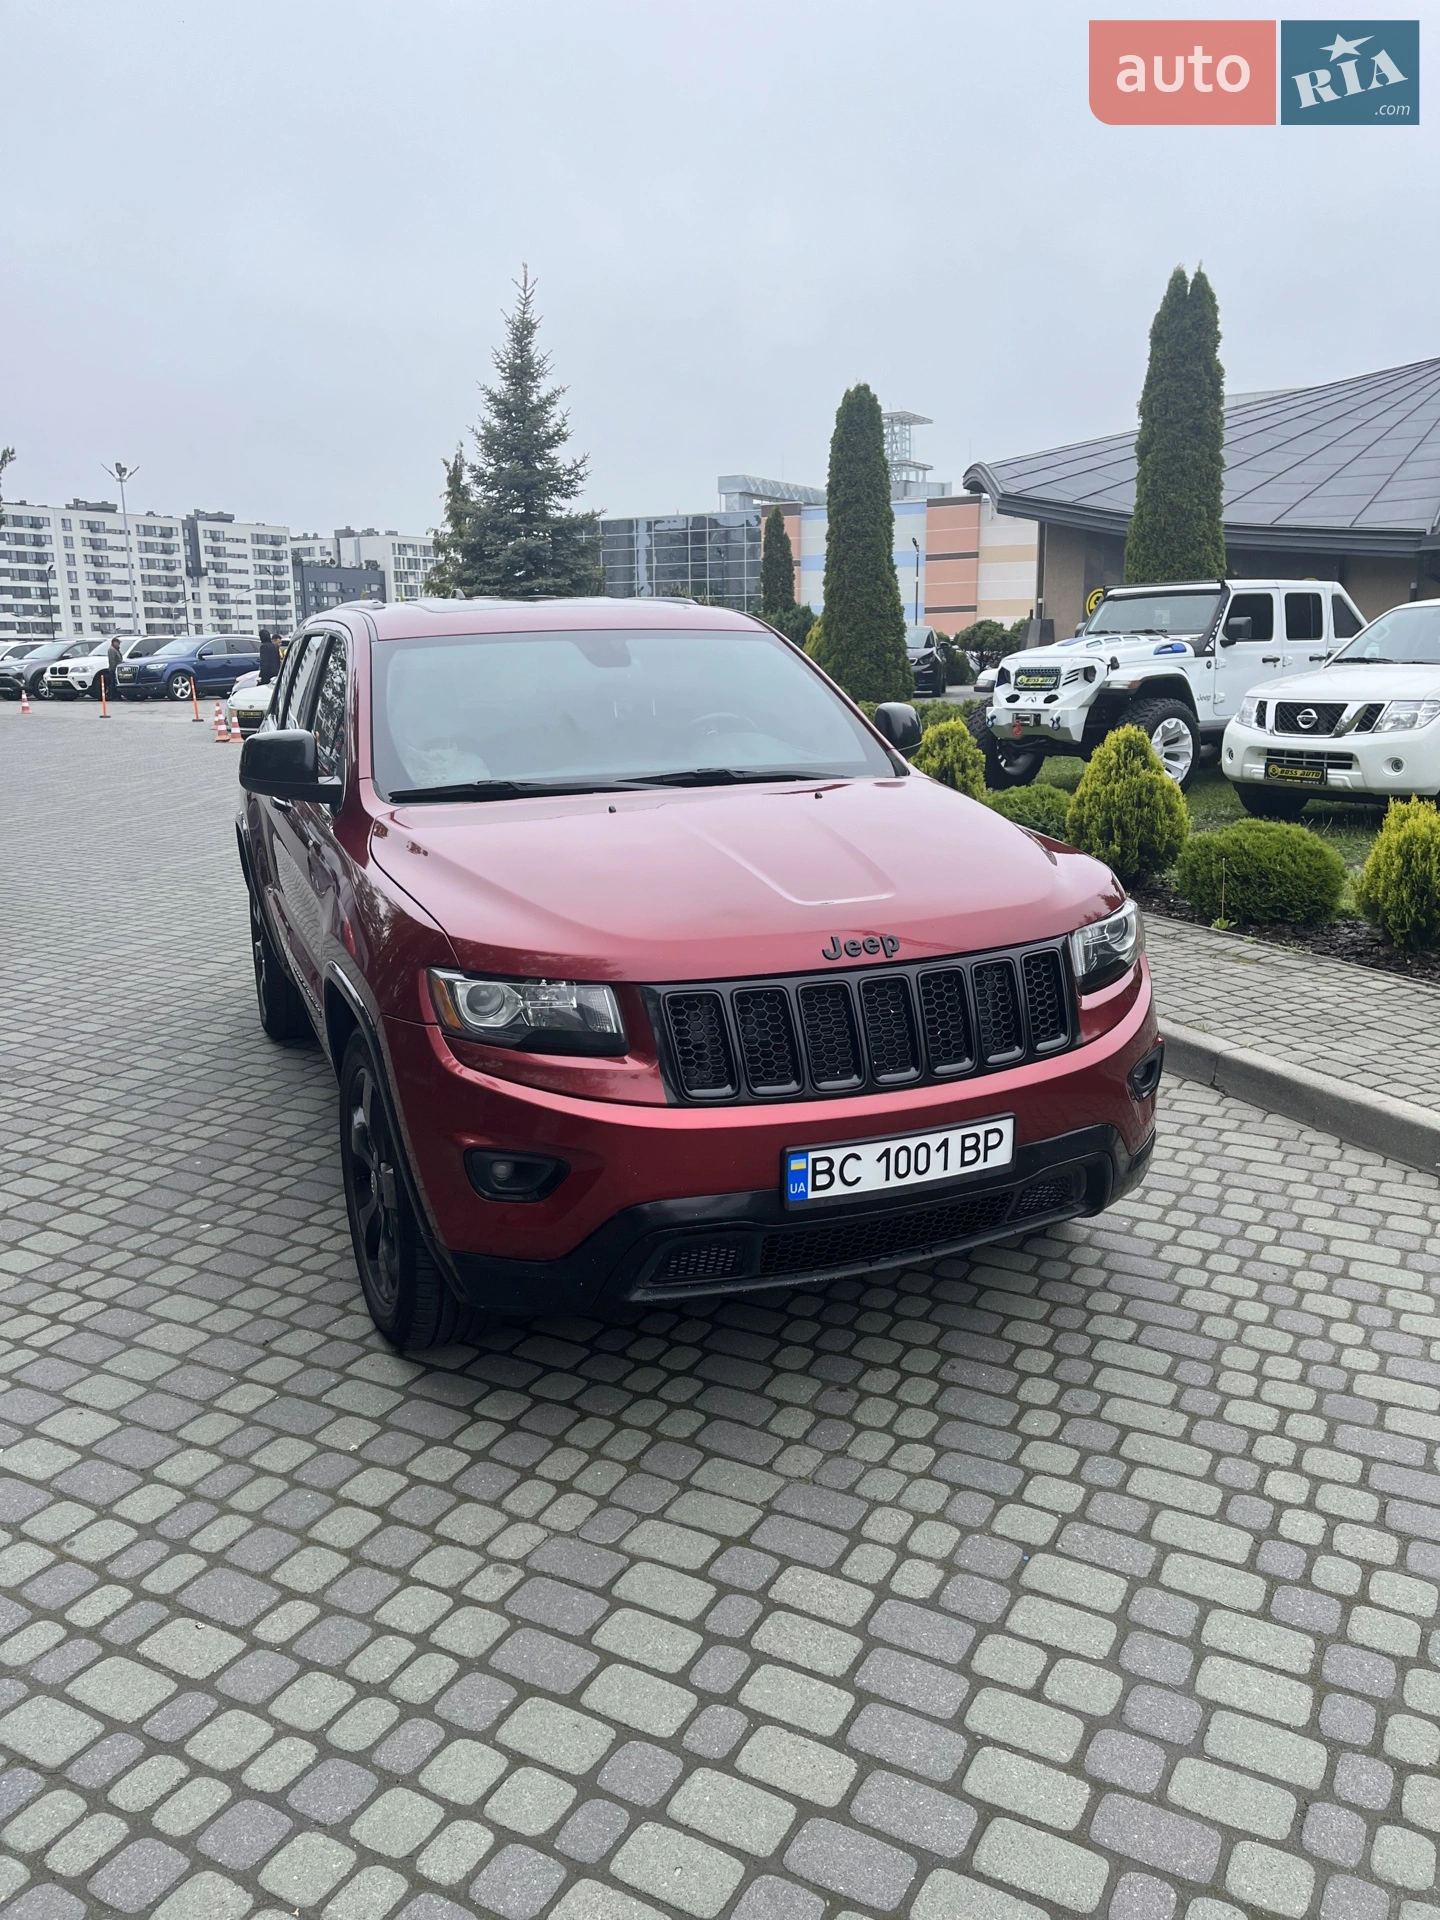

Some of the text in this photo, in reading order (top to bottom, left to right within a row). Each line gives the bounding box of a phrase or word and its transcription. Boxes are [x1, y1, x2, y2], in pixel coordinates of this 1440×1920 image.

[1279, 768, 1321, 778] BOSS AUTO
[822, 935, 900, 960] Jeep
[811, 1128, 1003, 1192] BC 1001 BP
[790, 1183, 806, 1194] UA
